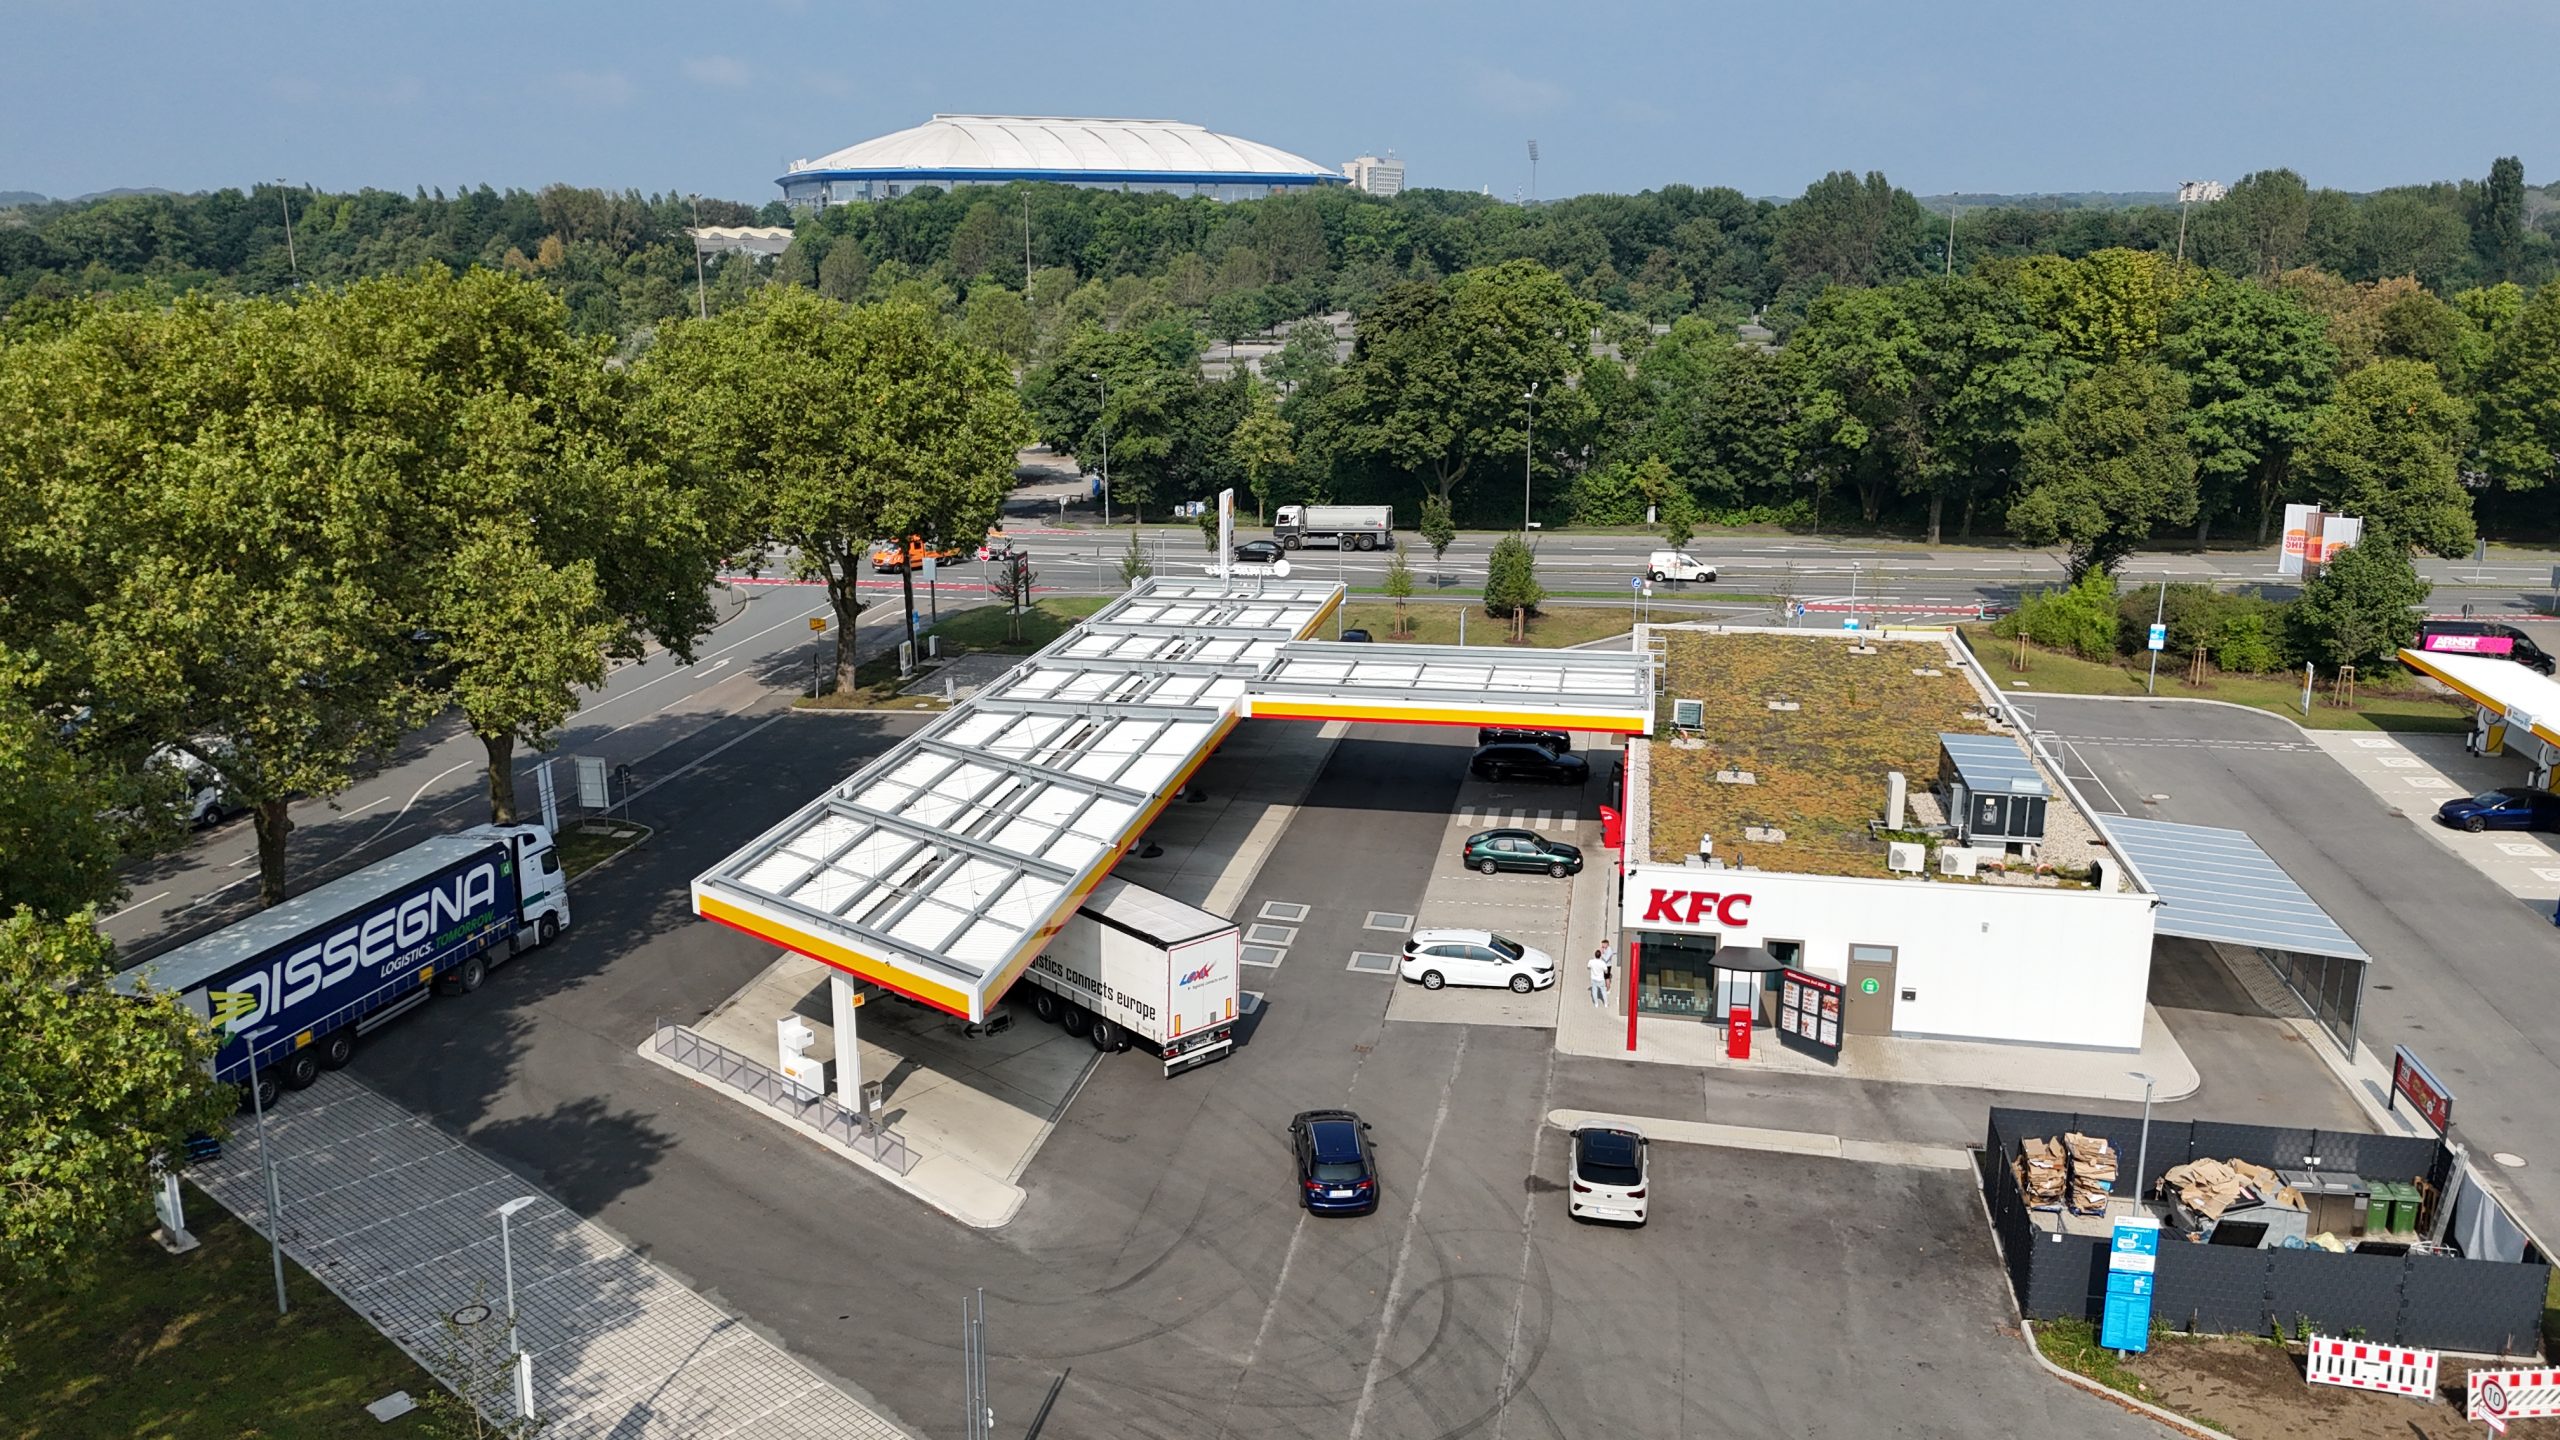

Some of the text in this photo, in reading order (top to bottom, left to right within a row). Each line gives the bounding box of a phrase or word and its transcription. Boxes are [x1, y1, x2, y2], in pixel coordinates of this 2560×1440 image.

[2432, 636, 2479, 650] ARNDT
[1643, 888, 1752, 926] KFC
[225, 862, 495, 1036] DISSEGNA
[381, 909, 496, 978] LOGISTICS. TOMORROW.
[1066, 966, 1114, 1001] connects
[1117, 990, 1156, 1021] europe
[2488, 1387, 2501, 1407] 10
